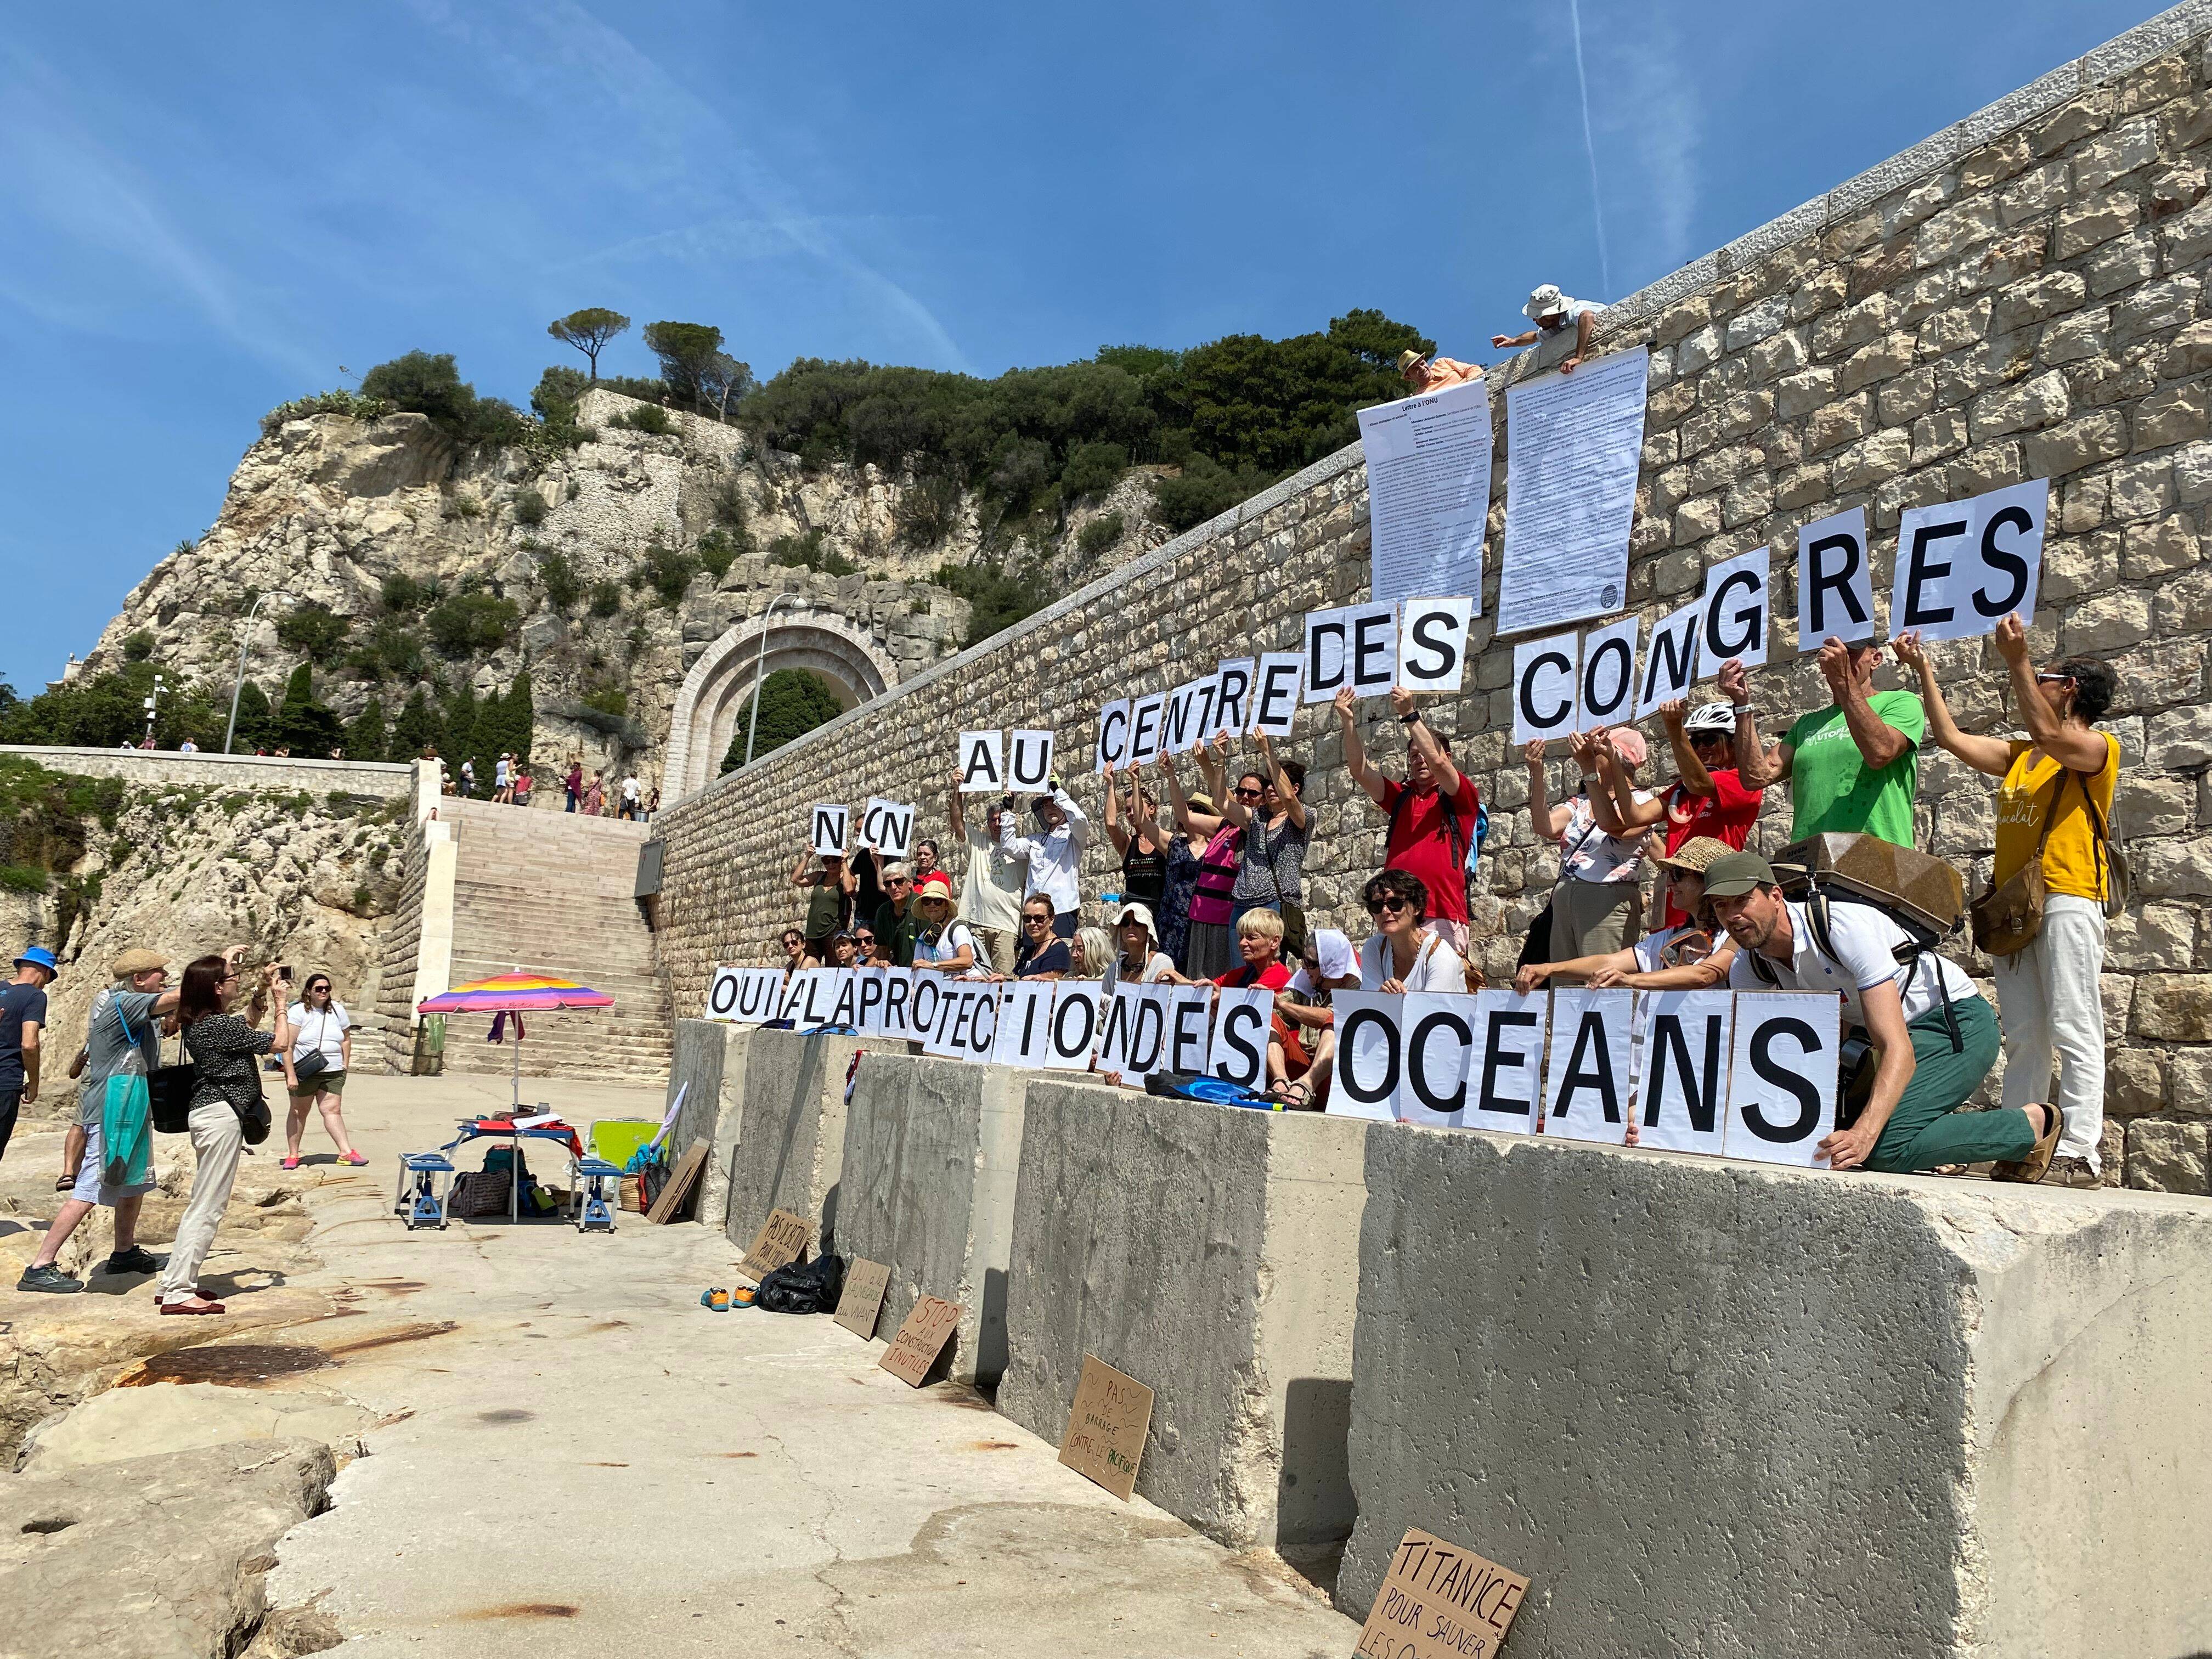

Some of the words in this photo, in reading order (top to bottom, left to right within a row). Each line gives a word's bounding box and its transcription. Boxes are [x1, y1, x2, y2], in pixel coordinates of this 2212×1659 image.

[1421, 398, 1438, 406] l'ONU
[963, 739, 1048, 785] AU
[1101, 665, 1298, 763] CENTRE
[1310, 612, 1459, 690] DES
[1520, 506, 2034, 728] CONGRES
[712, 975, 776, 1015] OUI
[859, 978, 1138, 1064] PROTECION
[1339, 1008, 1823, 1143] OCEANS
[765, 1215, 785, 1240] PAS
[916, 1298, 958, 1330] STOP
[918, 1327, 935, 1340] AUX
[1107, 1380, 1125, 1404] PAS
[1085, 1413, 1119, 1436] BARRAGE
[1070, 1432, 1094, 1453] CONTRE
[1097, 1444, 1105, 1458] LE
[1381, 1587, 1423, 1630] POUR
[1427, 1615, 1486, 1659] SAUVER
